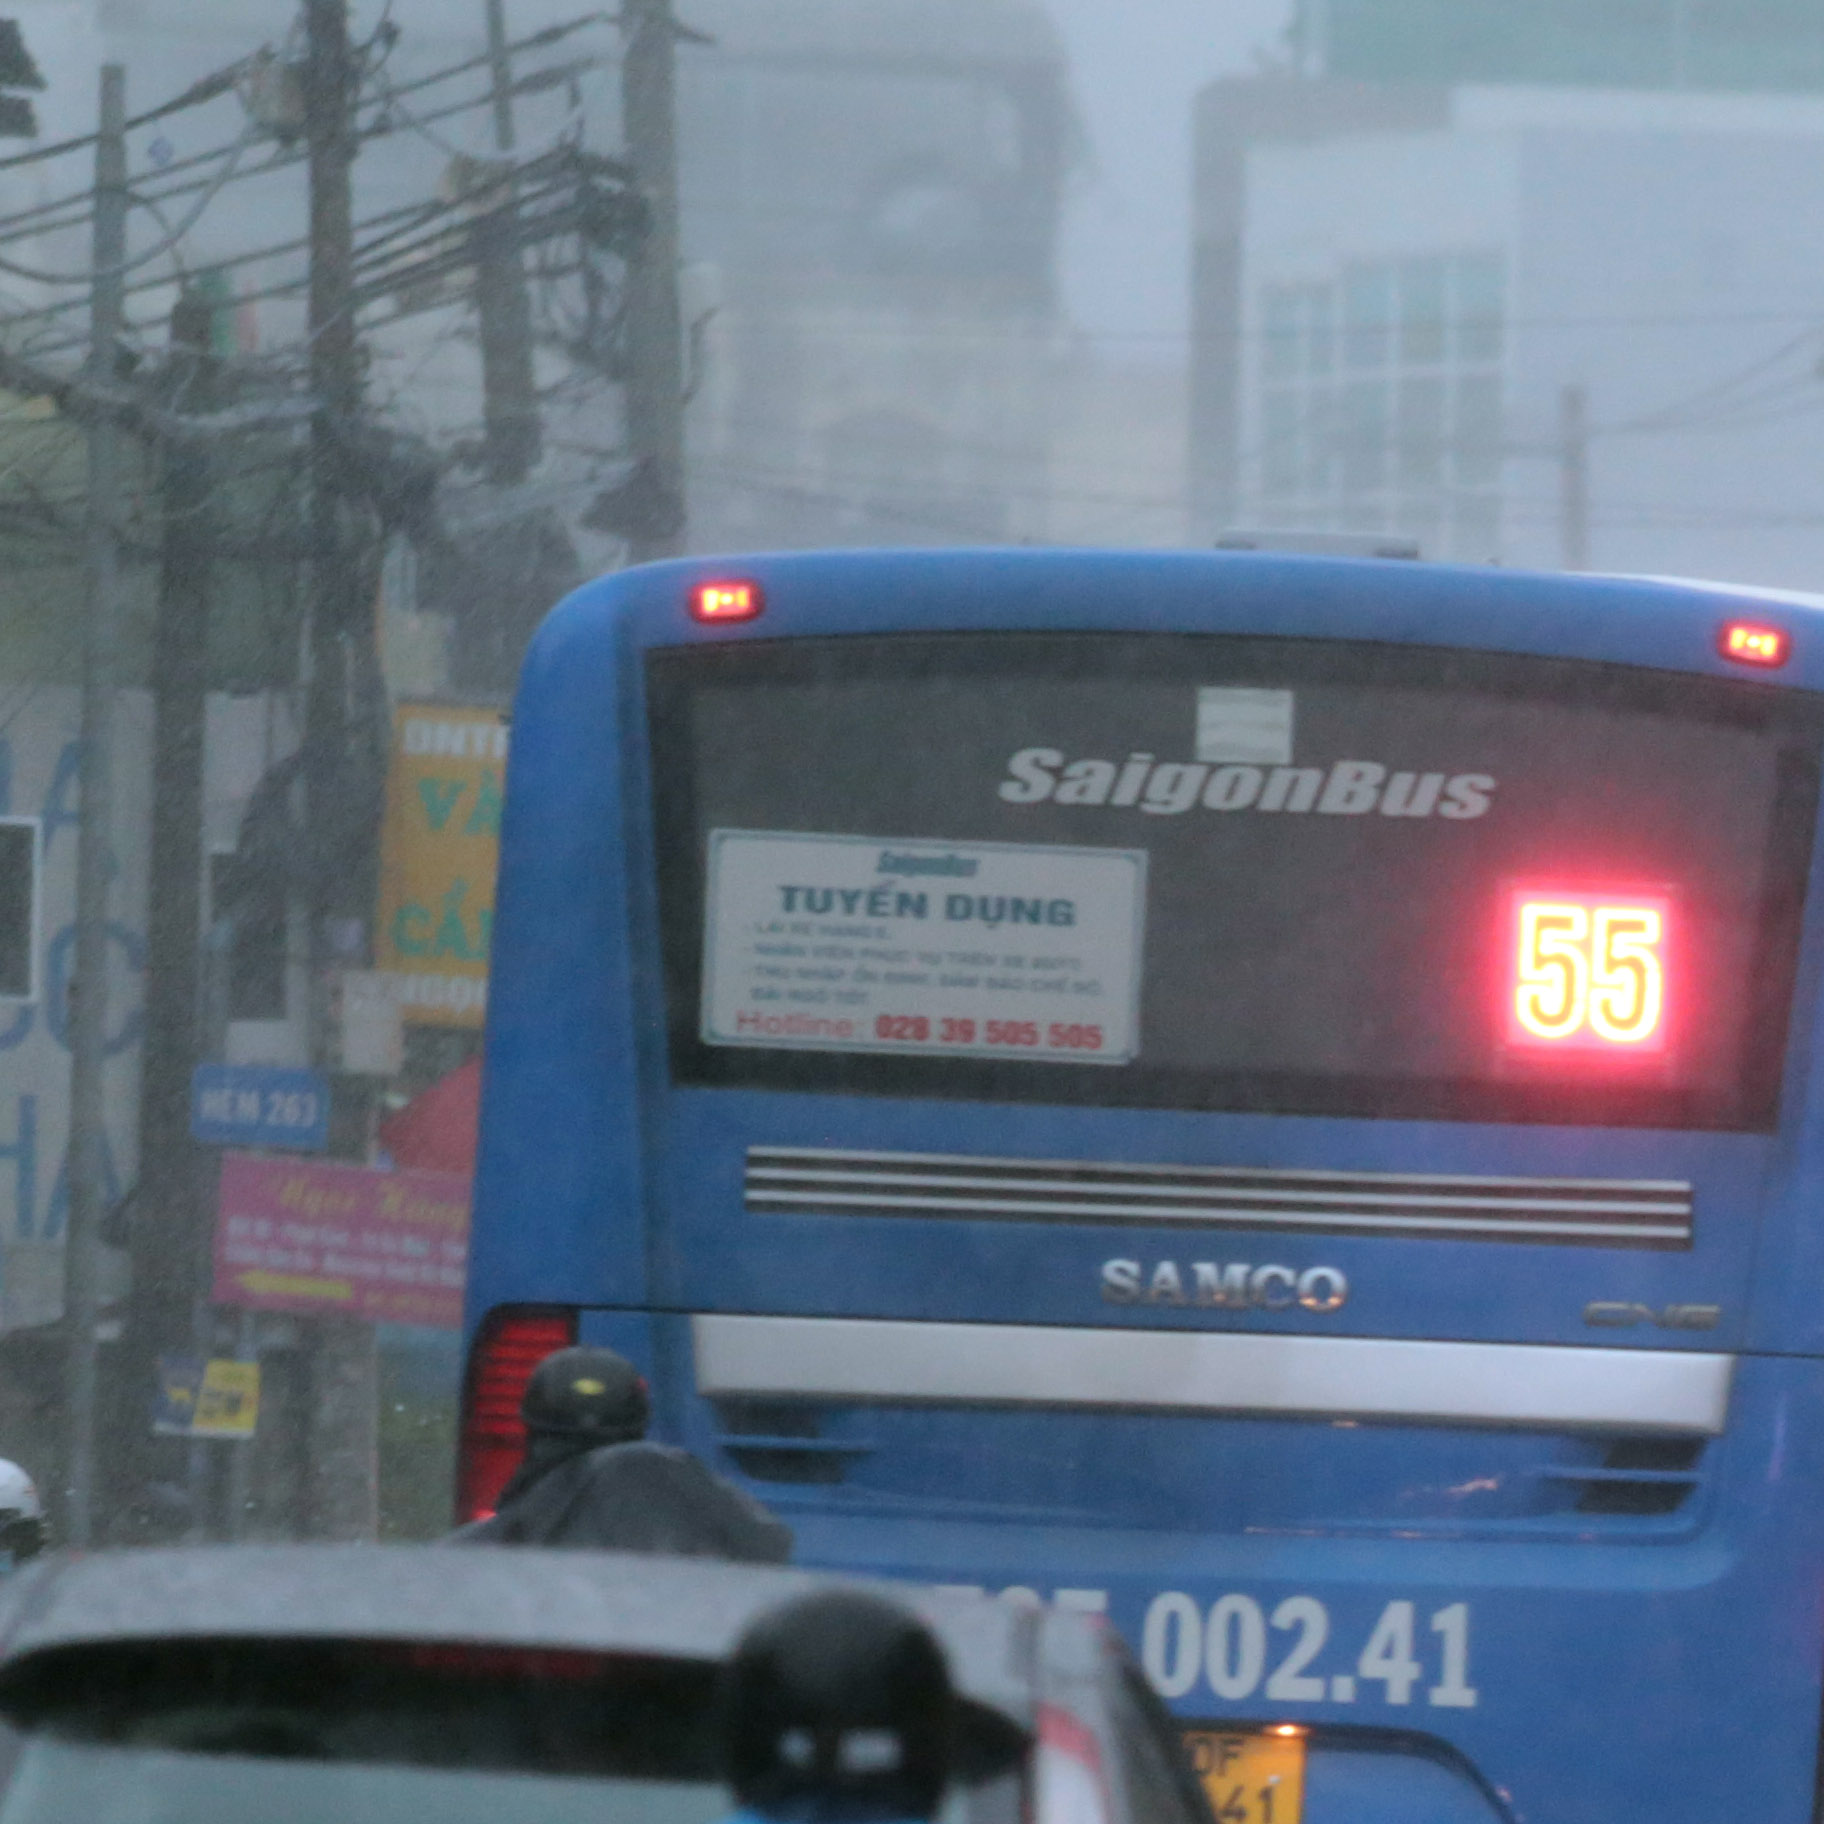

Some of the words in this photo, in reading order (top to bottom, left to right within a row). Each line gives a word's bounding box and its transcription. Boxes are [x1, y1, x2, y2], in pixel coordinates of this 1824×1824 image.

[999, 747, 1497, 820] SaigonBus
[945, 893, 1077, 930] DỤNG
[1513, 900, 1667, 1046] 55
[875, 1014, 930, 1041] 028
[985, 1019, 1040, 1046] 505
[1049, 1021, 1103, 1049] 505
[1101, 1257, 1349, 1313] SAMCO
[1141, 1591, 1478, 1708] 002.41
